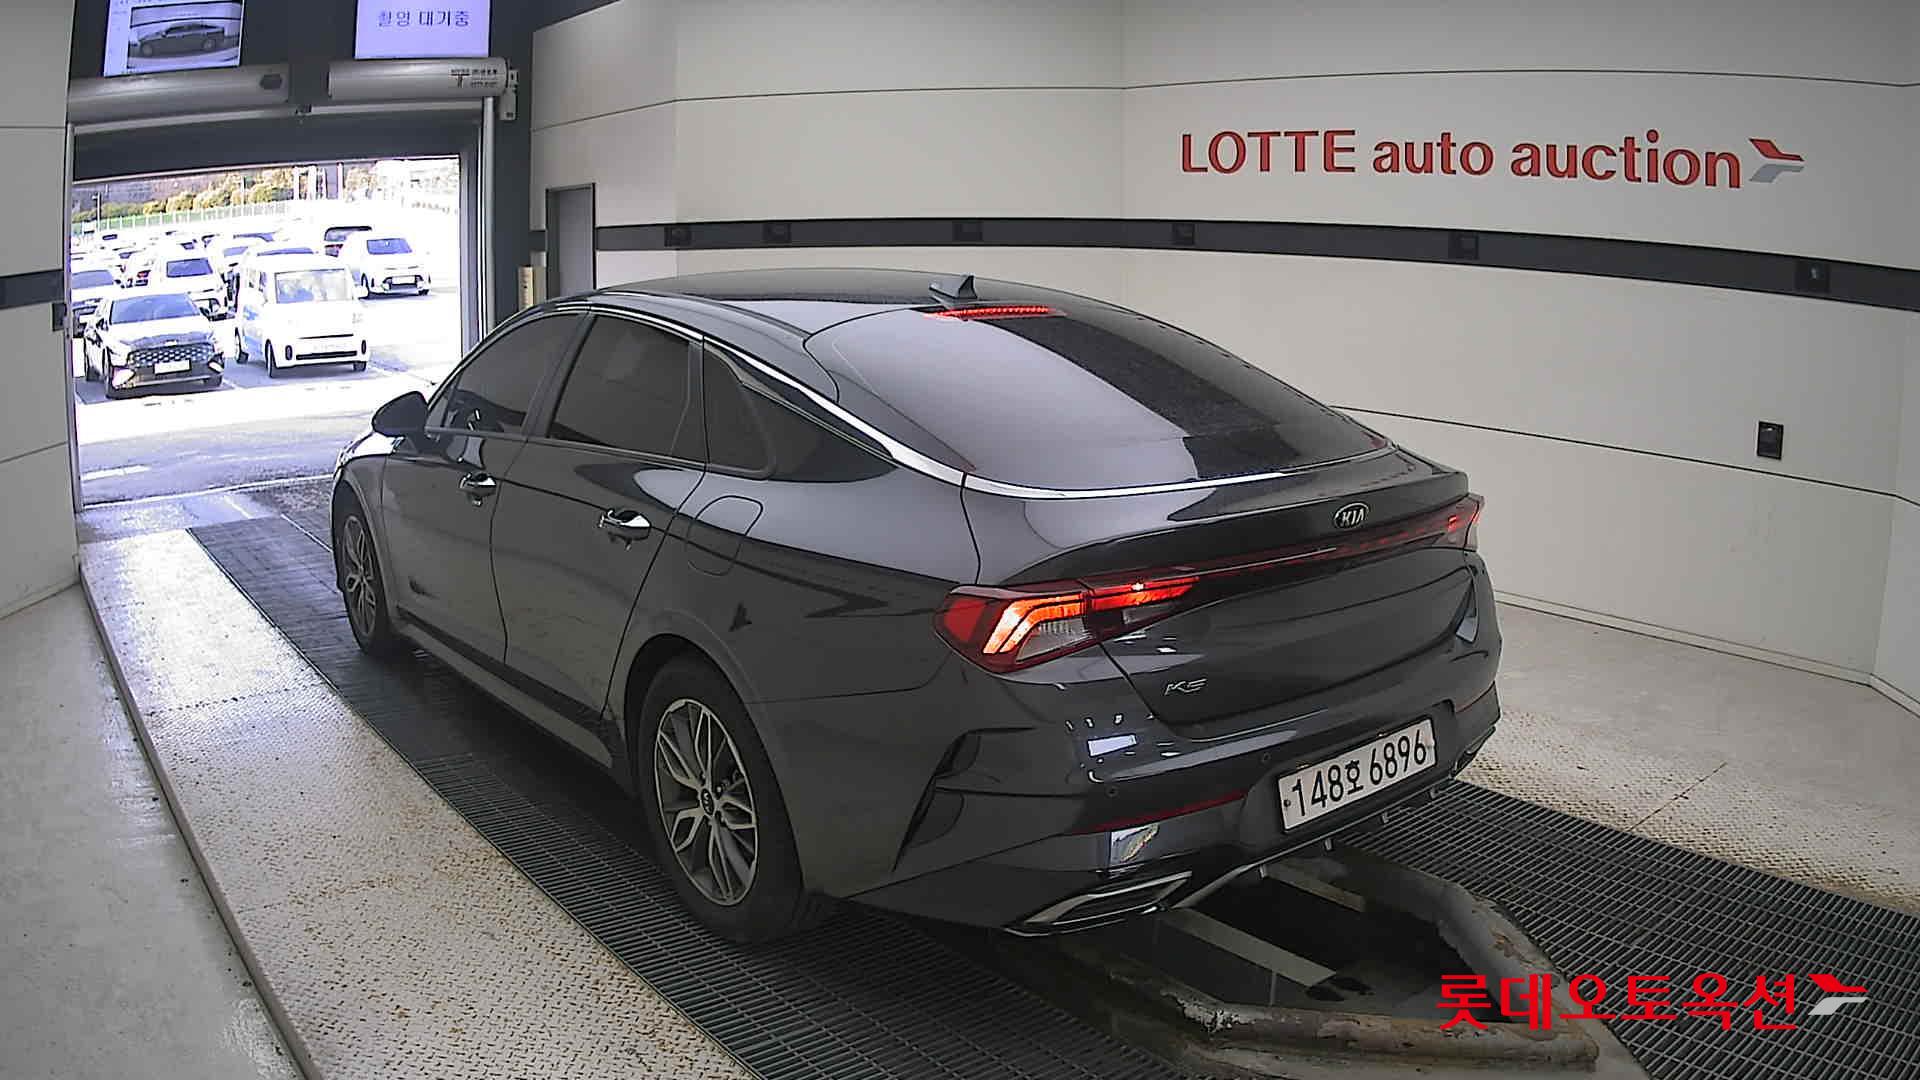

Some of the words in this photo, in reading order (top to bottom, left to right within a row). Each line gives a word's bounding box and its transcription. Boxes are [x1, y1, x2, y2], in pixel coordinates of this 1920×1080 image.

[1182, 130, 1356, 173] LOTTE
[1373, 132, 1495, 176] auto
[1511, 129, 1742, 189] auction
[1340, 507, 1365, 527] KIA
[1292, 759, 1364, 817] 148호
[1369, 729, 1428, 786] 6896
